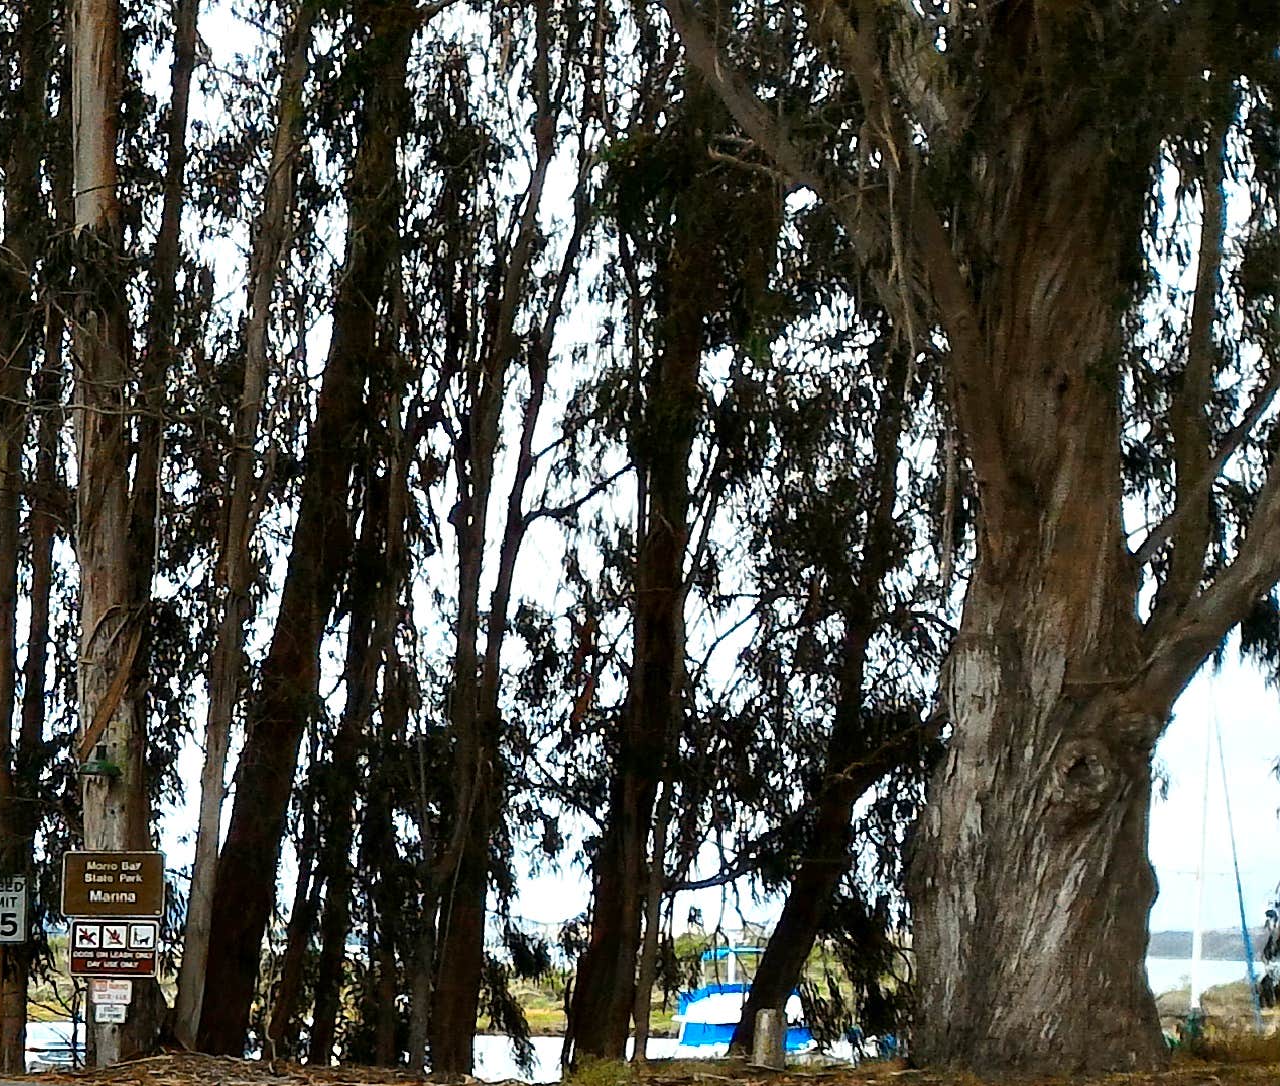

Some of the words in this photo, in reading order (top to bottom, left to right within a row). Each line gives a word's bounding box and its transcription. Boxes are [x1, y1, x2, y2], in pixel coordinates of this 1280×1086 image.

[86, 861, 118, 871] Morro
[121, 861, 142, 871] Bay
[84, 873, 113, 883] State
[119, 873, 143, 883] Park
[89, 890, 136, 903] Marina
